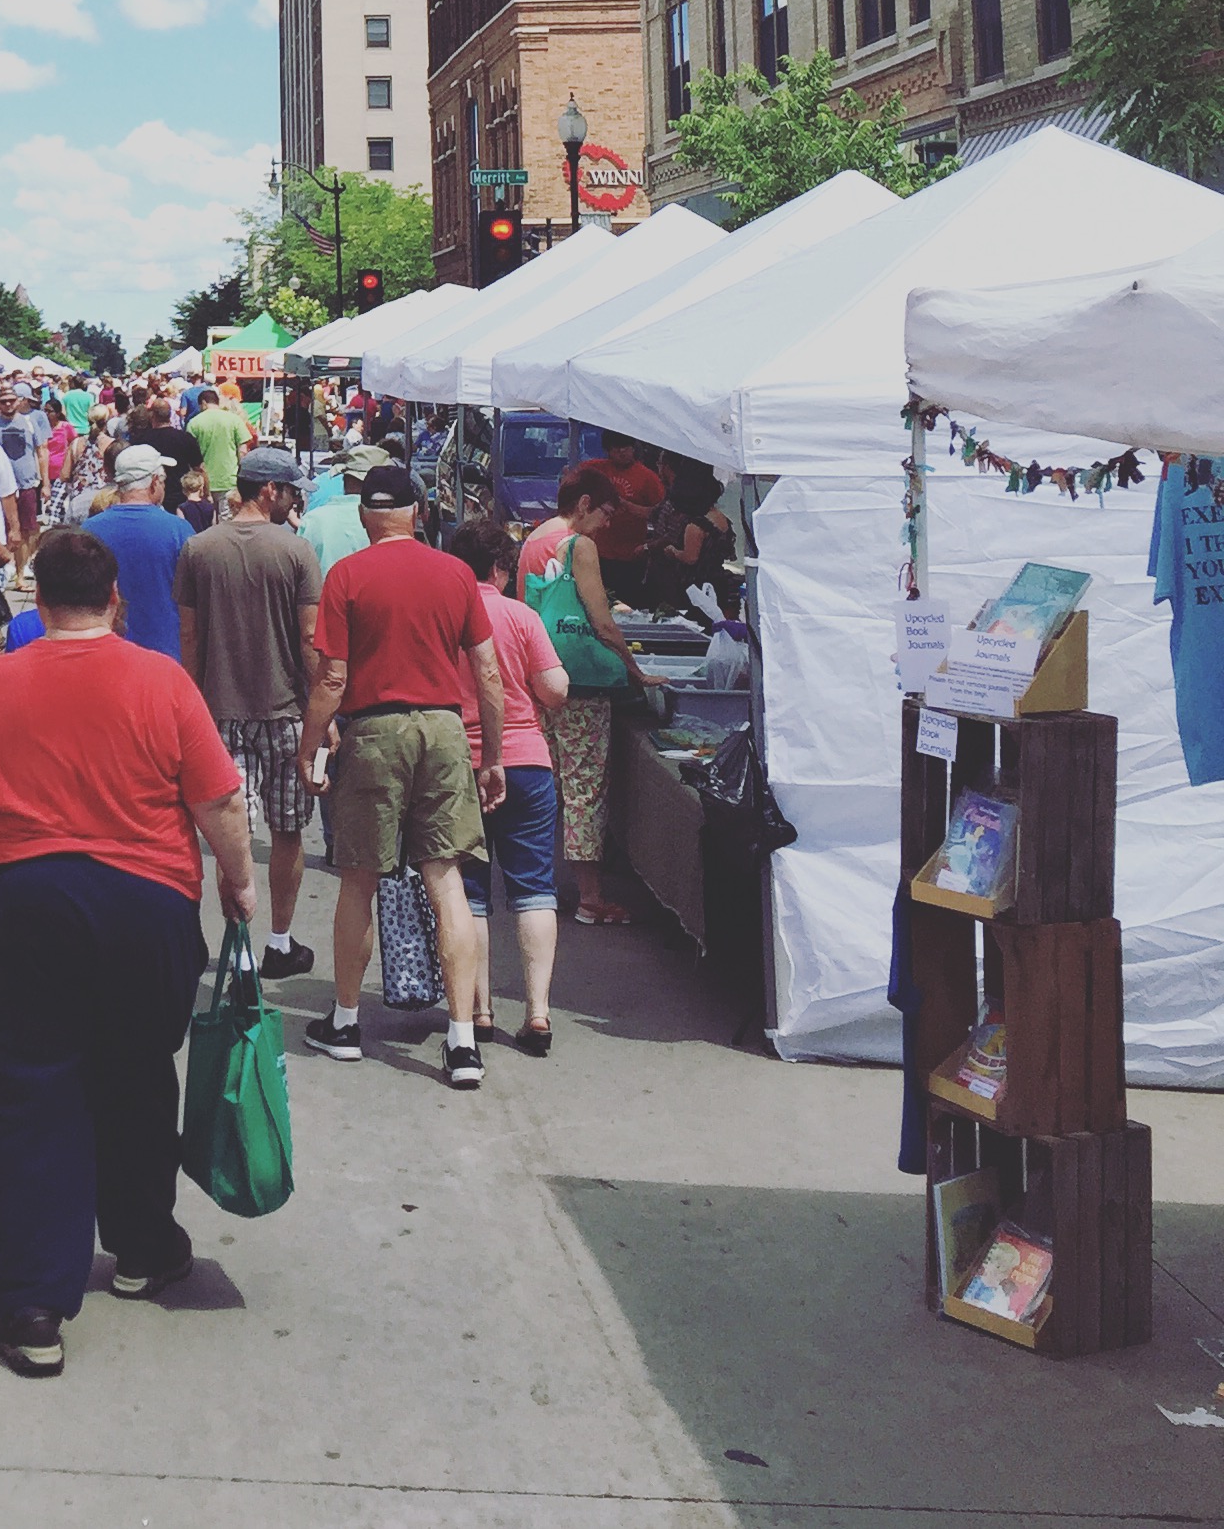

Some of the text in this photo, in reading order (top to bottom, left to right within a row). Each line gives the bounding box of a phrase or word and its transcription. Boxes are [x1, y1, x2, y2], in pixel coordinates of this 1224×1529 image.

[473, 172, 511, 184] Merritt
[904, 613, 945, 625] Upcycled
[906, 626, 929, 636] Book
[907, 640, 945, 650] Journals
[976, 634, 1016, 649] Upcycled
[974, 649, 1011, 662] Journals
[920, 726, 940, 740] Book
